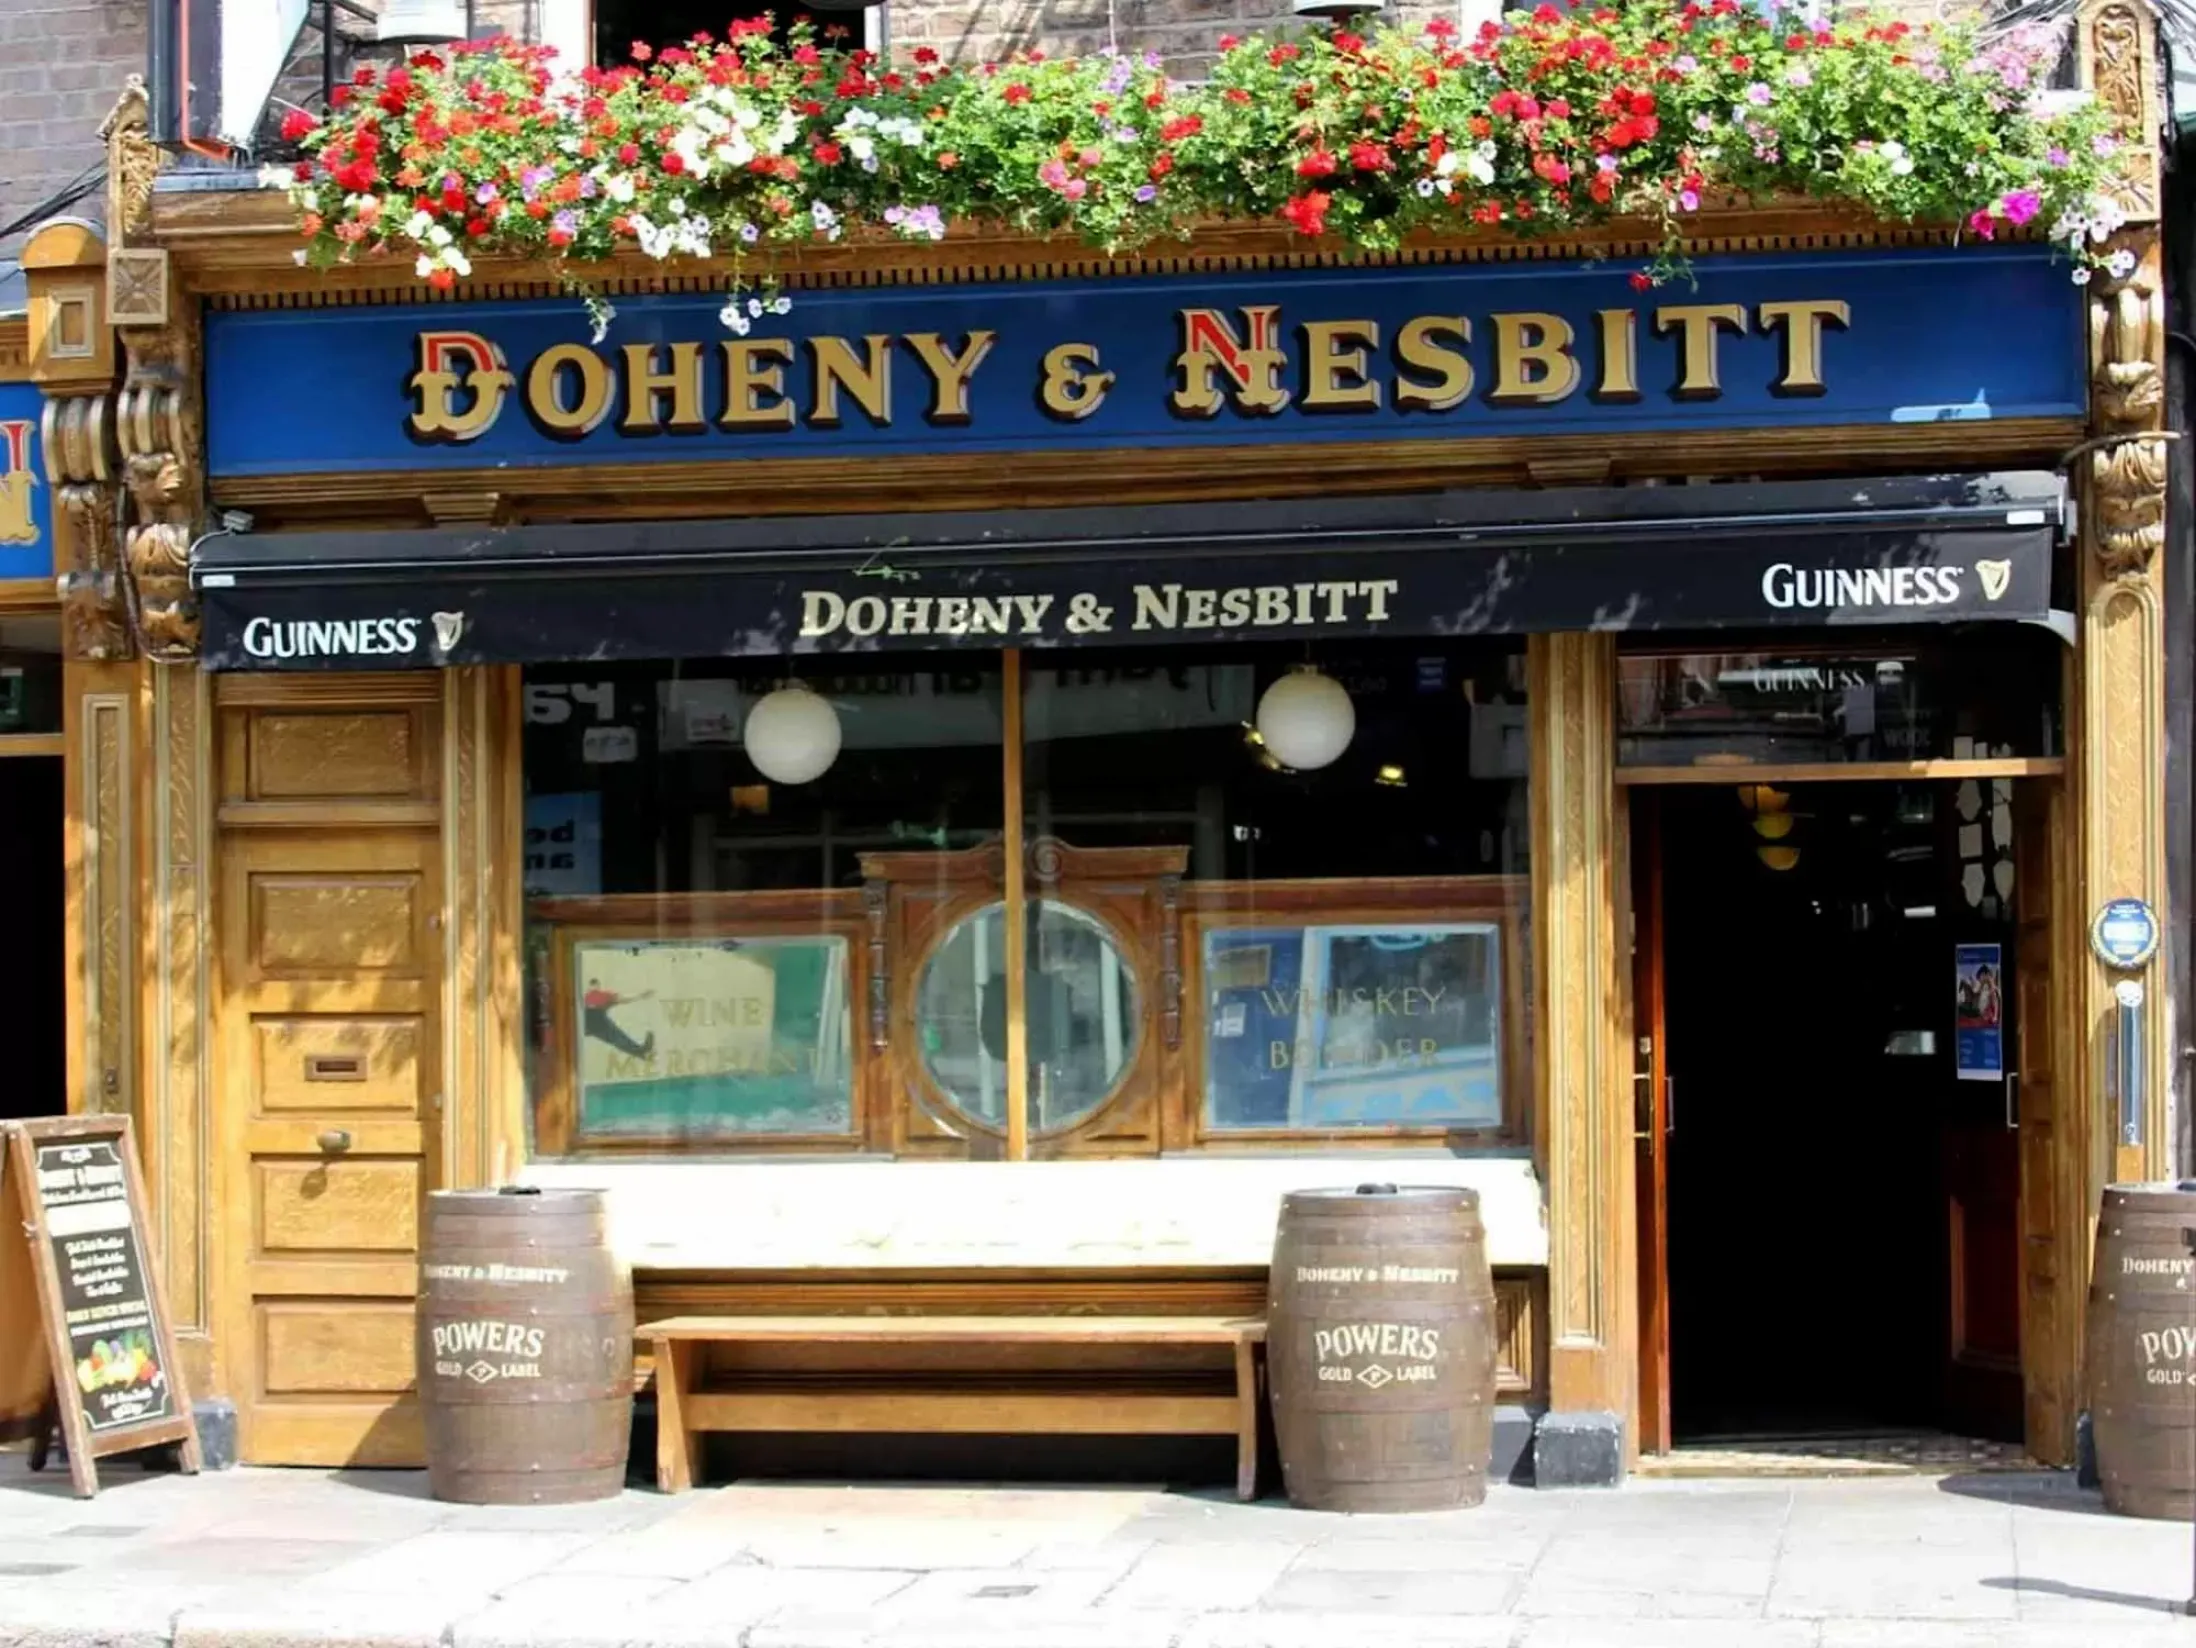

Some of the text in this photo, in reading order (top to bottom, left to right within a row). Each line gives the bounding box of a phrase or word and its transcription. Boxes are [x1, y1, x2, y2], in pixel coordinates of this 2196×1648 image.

[411, 300, 1851, 442] DOHENY & NESBITT
[1761, 563, 1963, 608] GUINNESS
[798, 580, 1398, 637] DOHENY & NESBITT
[242, 615, 422, 658] GUINNESS
[659, 997, 764, 1029] WINE
[1270, 1037, 1438, 1070] BODER
[1296, 1265, 1364, 1283] DOHENY
[2121, 1256, 2194, 1274] DOHENY
[432, 1319, 546, 1358] POWERS
[1315, 1323, 1440, 1363] POWERS
[501, 1362, 542, 1378] LABEL
[1318, 1365, 1353, 1381] GOLD
[1396, 1364, 1437, 1382] LABEL
[2146, 1367, 2183, 1385] GOLD
